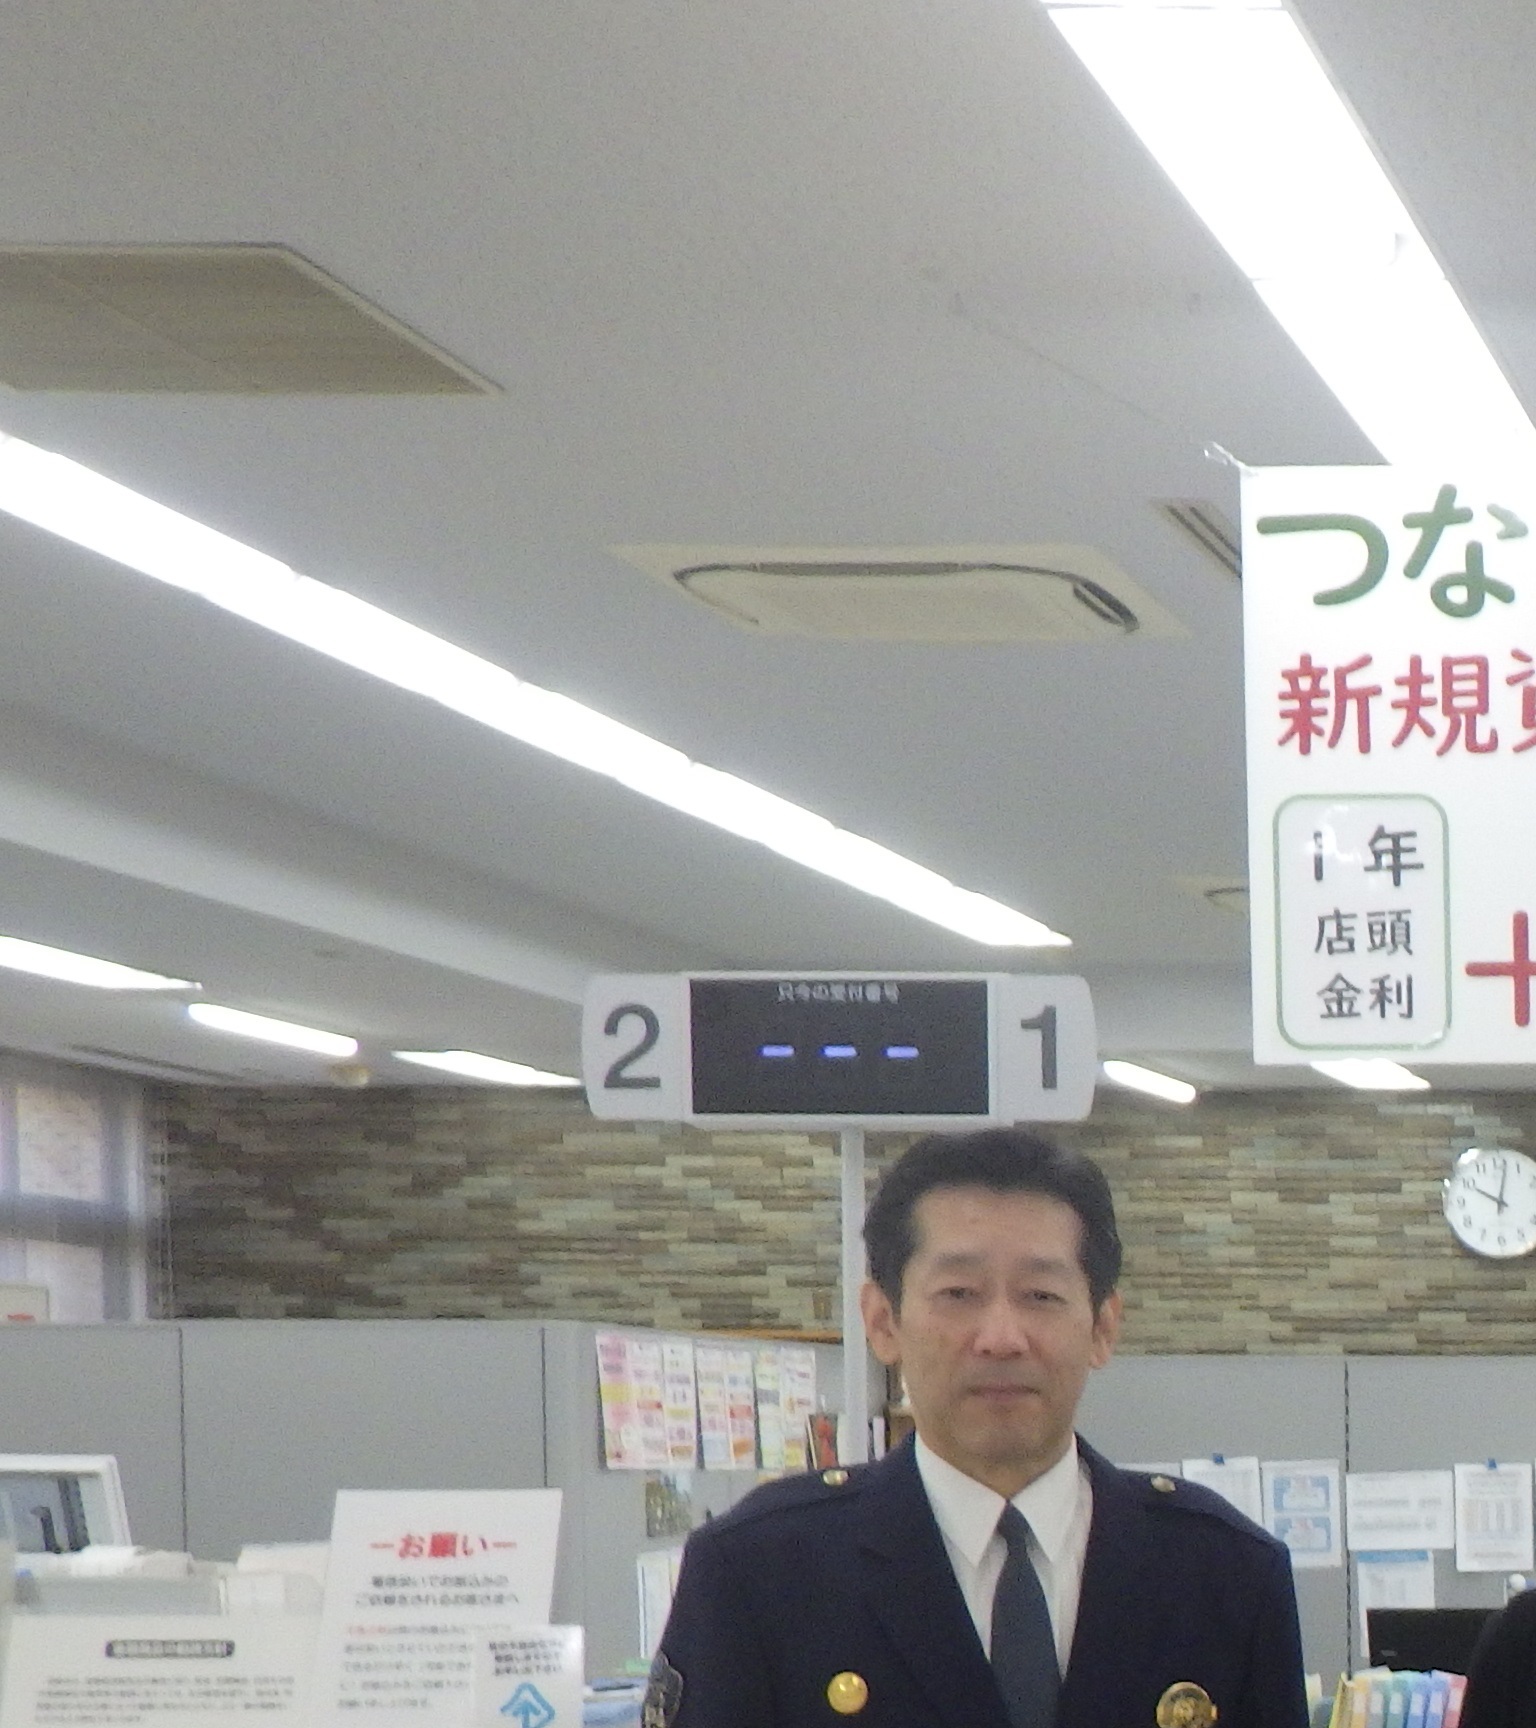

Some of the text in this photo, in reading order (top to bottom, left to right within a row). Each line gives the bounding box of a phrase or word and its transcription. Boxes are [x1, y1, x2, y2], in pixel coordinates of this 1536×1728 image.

[1314, 909, 1413, 957] 店頭
[1317, 974, 1415, 1022] 金利
[603, 1003, 662, 1089] 2
[1020, 1005, 1058, 1090] 1
